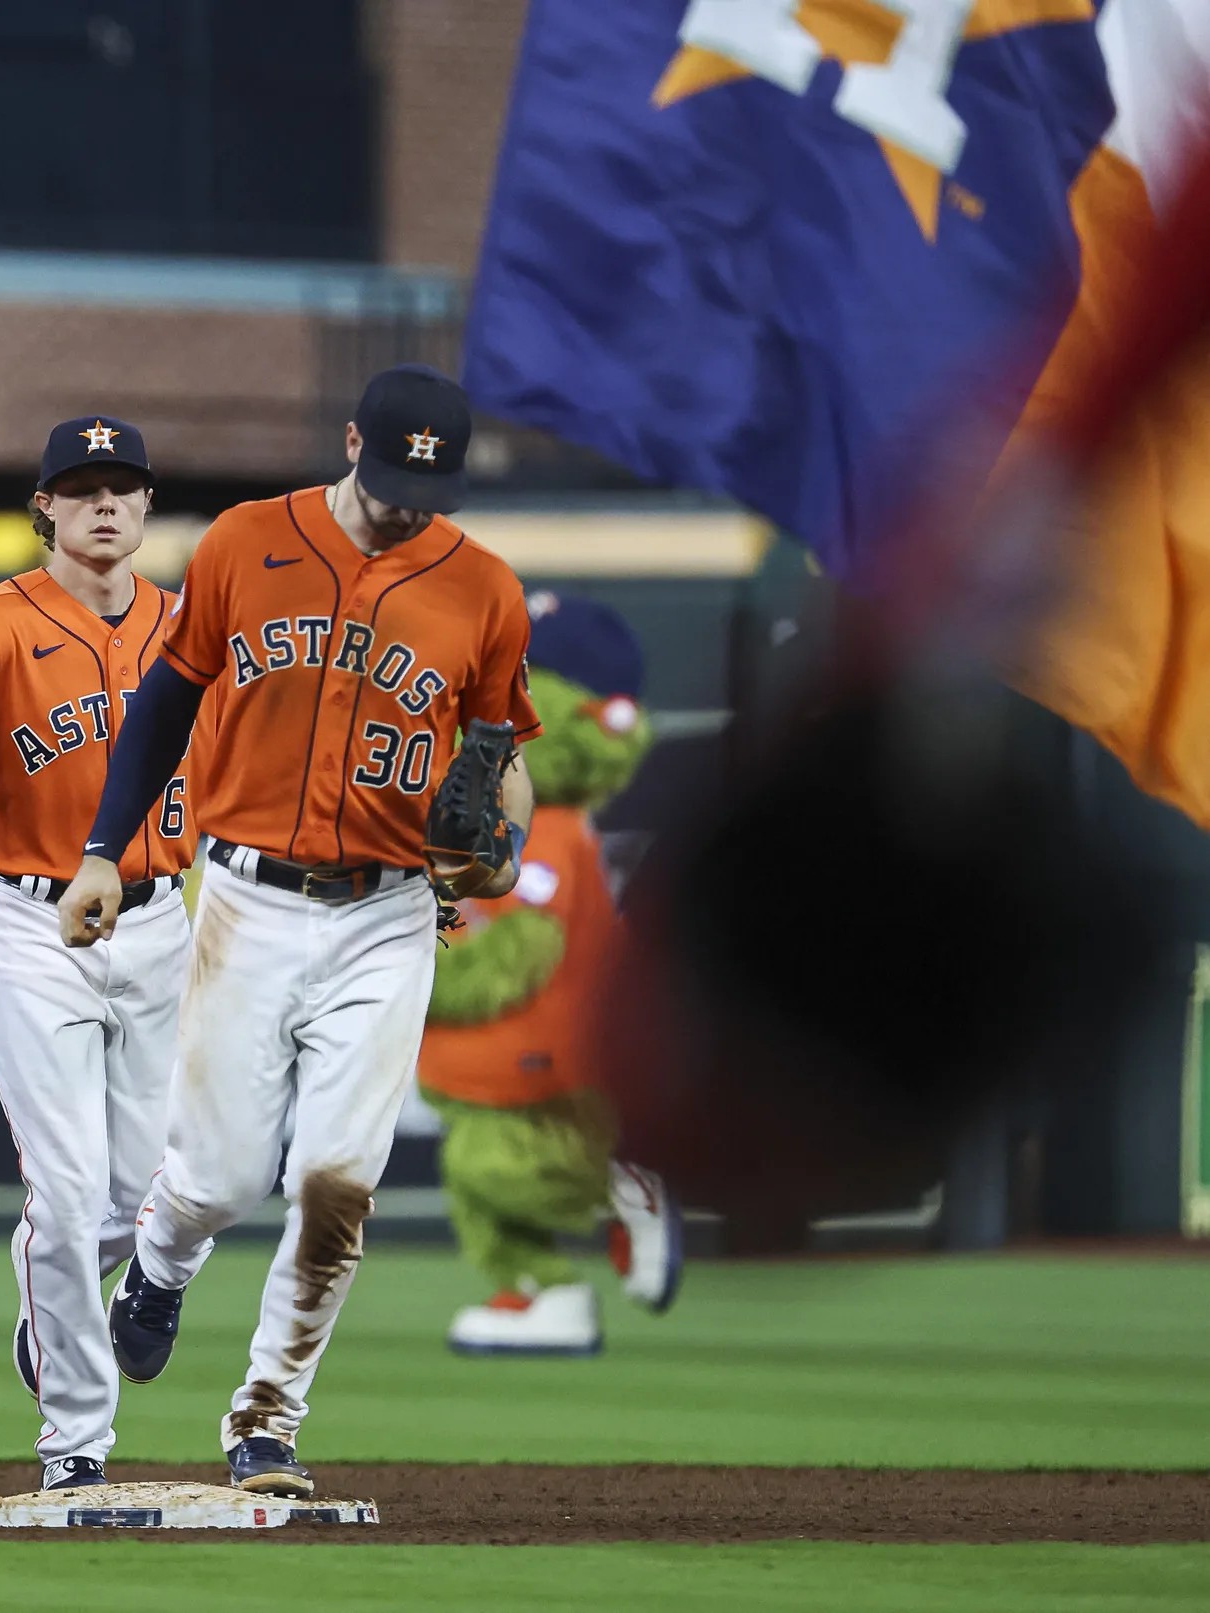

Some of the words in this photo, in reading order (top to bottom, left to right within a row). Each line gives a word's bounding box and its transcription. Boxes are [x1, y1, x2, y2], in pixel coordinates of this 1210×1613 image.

[86, 427, 114, 449] H
[407, 433, 440, 460] H
[228, 616, 447, 715] ASTROS
[353, 720, 435, 794] 30
[159, 776, 186, 838] 6
